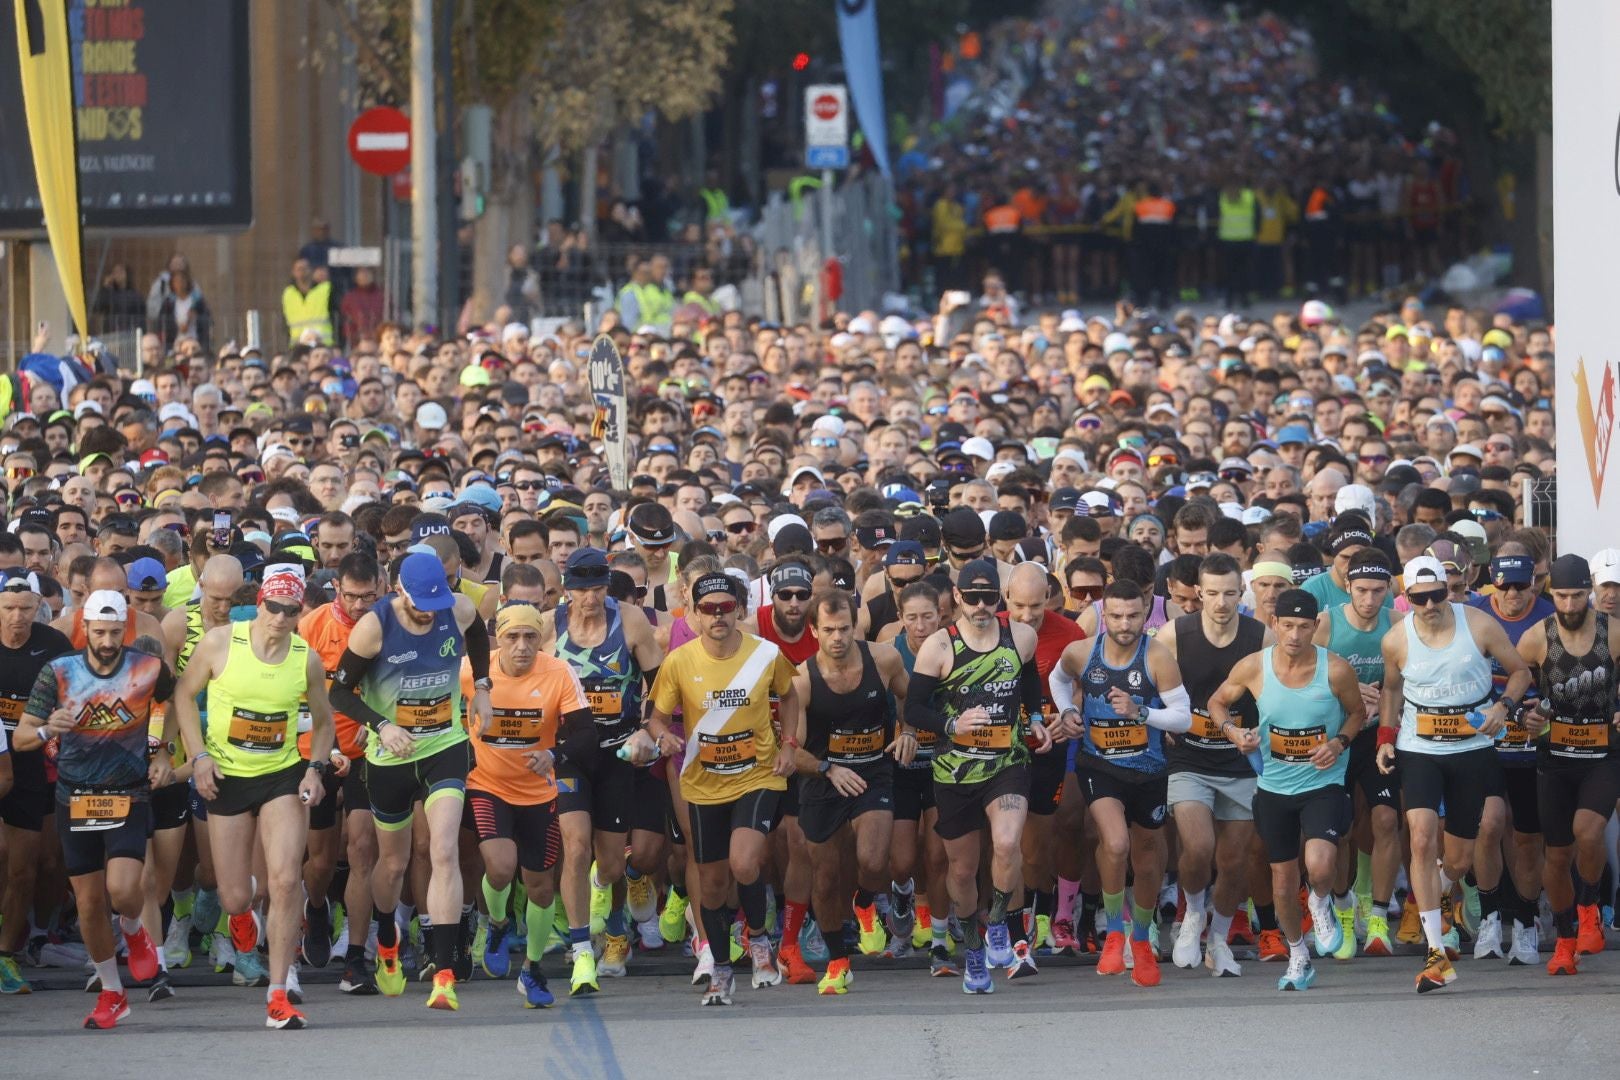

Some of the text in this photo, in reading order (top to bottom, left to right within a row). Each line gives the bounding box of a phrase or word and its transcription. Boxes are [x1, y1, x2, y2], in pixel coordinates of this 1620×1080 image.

[1432, 718, 1460, 726] 11278
[1104, 729, 1130, 739] 10157
[715, 745, 738, 755] 9704
[86, 798, 114, 808] 11360
